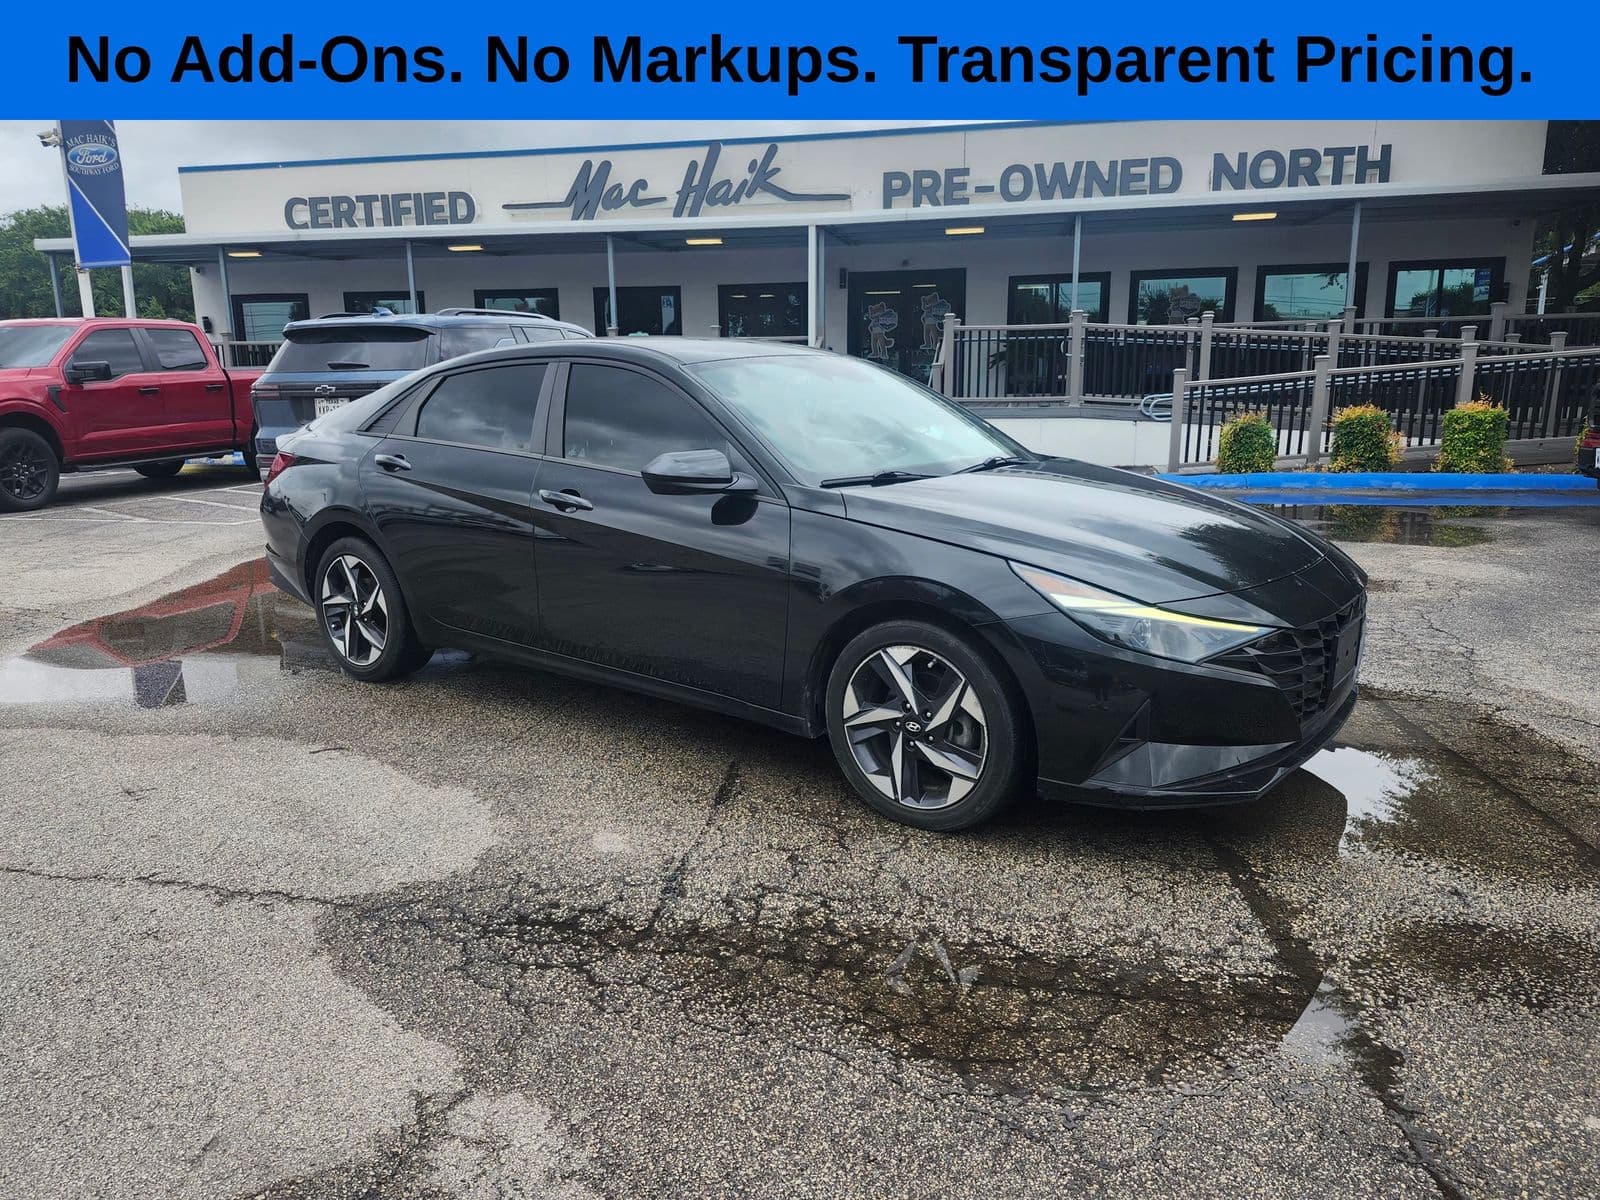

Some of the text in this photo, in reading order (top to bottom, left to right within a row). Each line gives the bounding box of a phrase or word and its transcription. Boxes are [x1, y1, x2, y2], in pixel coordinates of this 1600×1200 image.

[66, 135, 84, 149] MAC
[76, 147, 107, 164] Ford
[102, 162, 119, 174] FORD
[502, 141, 851, 221] Mac Haik
[882, 144, 1393, 210] PRE-OWNED NORTH
[284, 191, 476, 230] CERTIFIED
